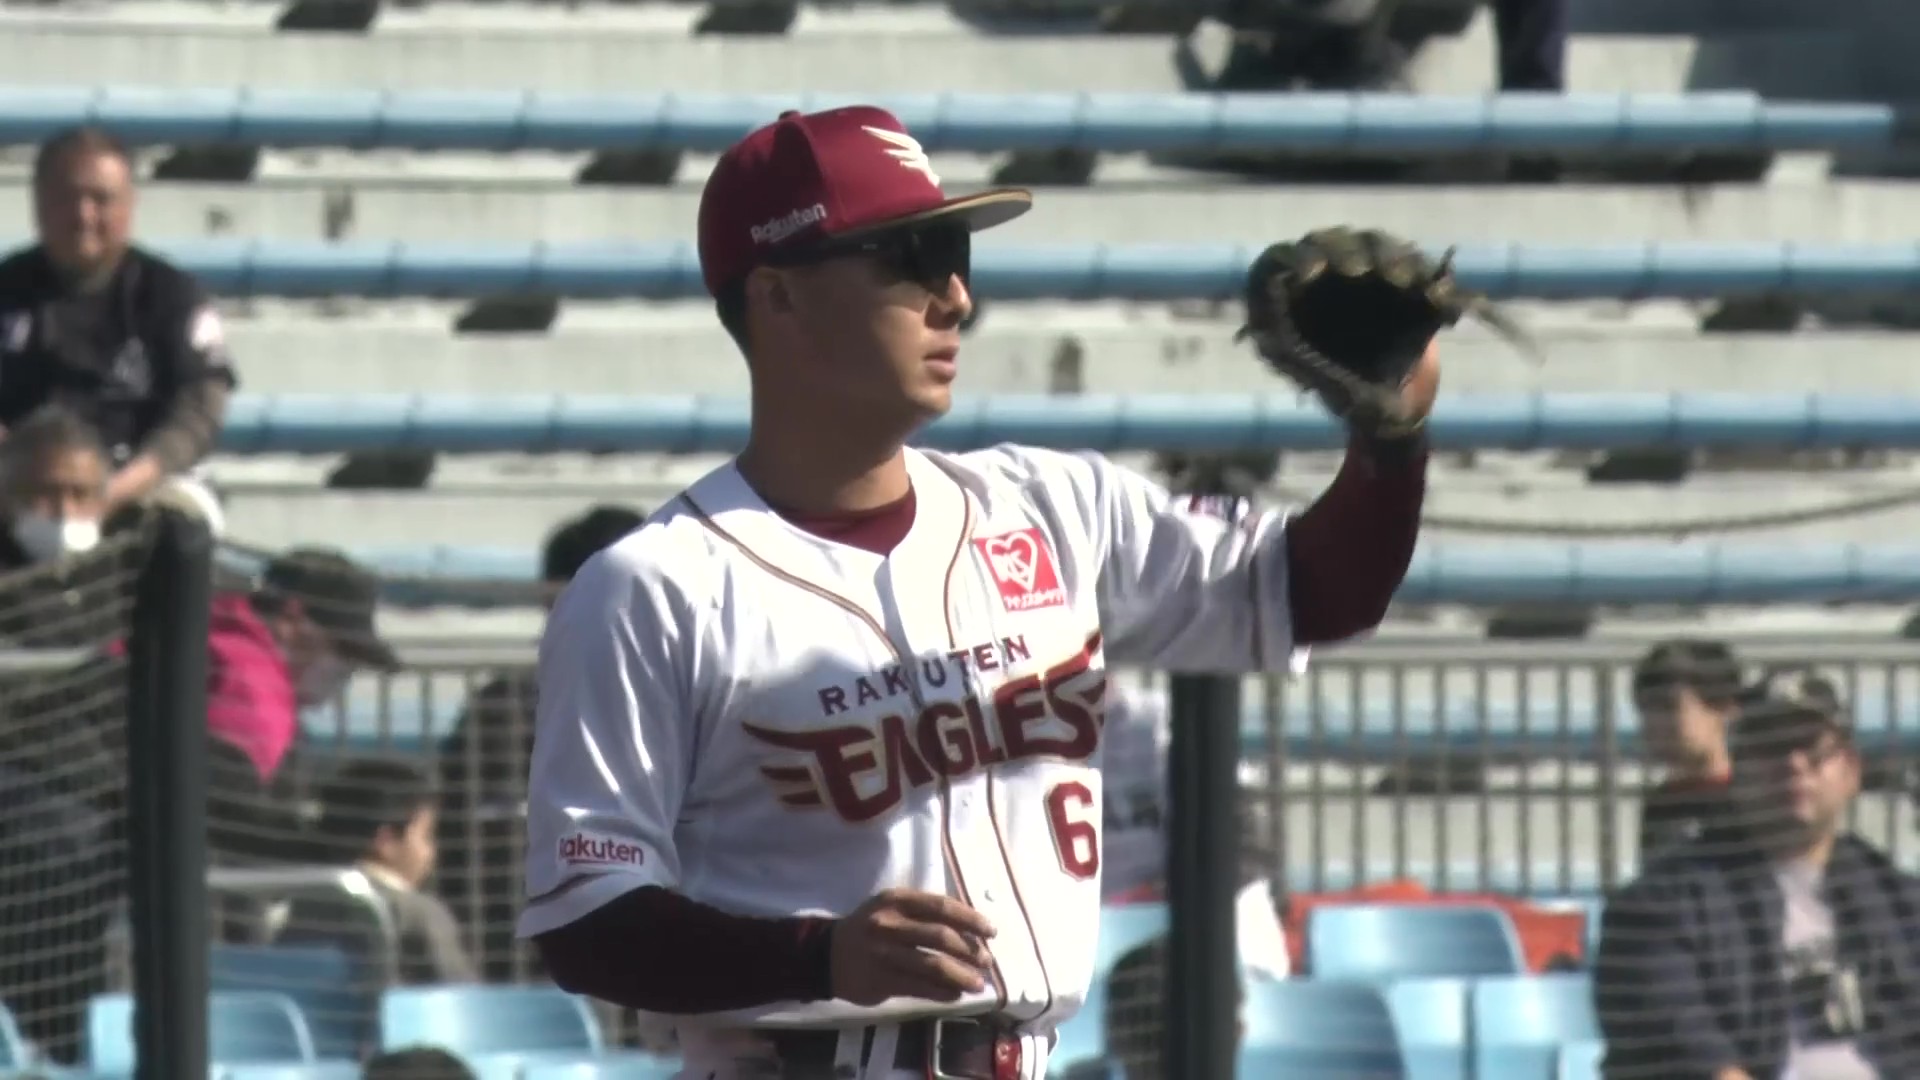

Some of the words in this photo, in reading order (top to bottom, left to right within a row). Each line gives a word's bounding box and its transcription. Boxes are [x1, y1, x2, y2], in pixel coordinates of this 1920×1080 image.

[750, 203, 827, 244] Rakuten
[817, 634, 1031, 716] RAKUTEN
[741, 632, 1105, 822] EAGLES
